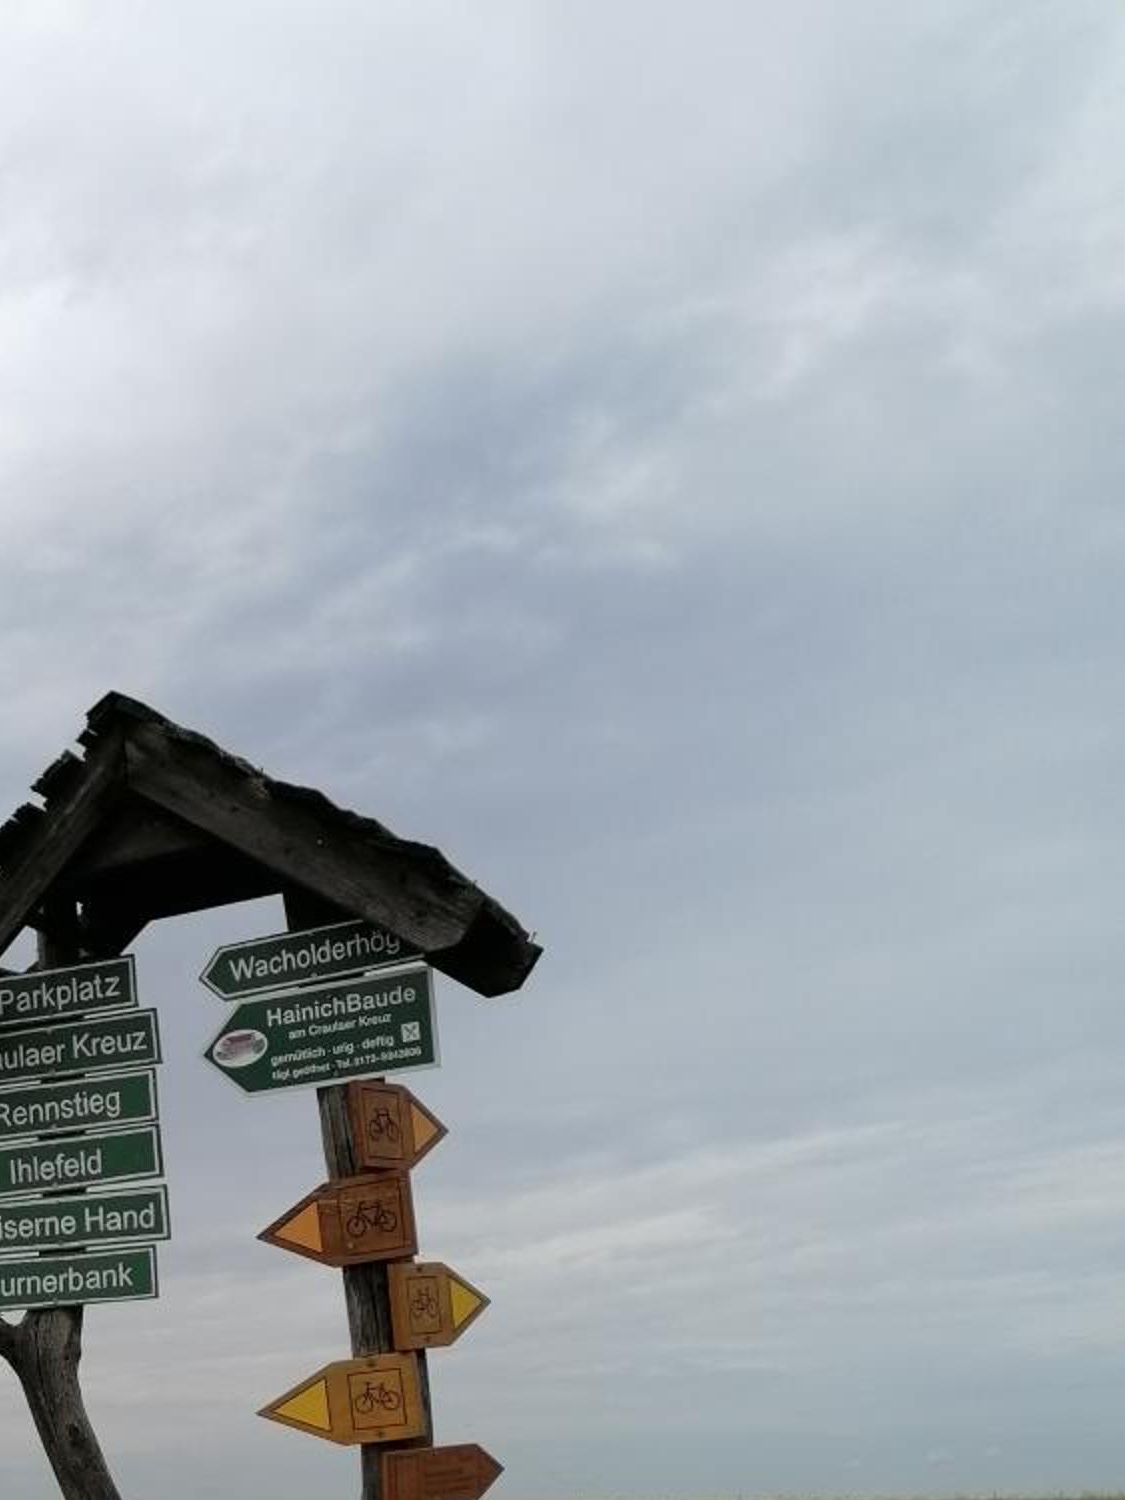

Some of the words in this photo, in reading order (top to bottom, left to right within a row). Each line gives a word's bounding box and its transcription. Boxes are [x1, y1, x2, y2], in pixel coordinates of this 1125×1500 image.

[266, 985, 417, 1028] HainichBaude
[72, 1030, 149, 1060] Kreuz
[9, 1148, 103, 1185] Ihlefeld
[83, 1201, 156, 1233] Hand
